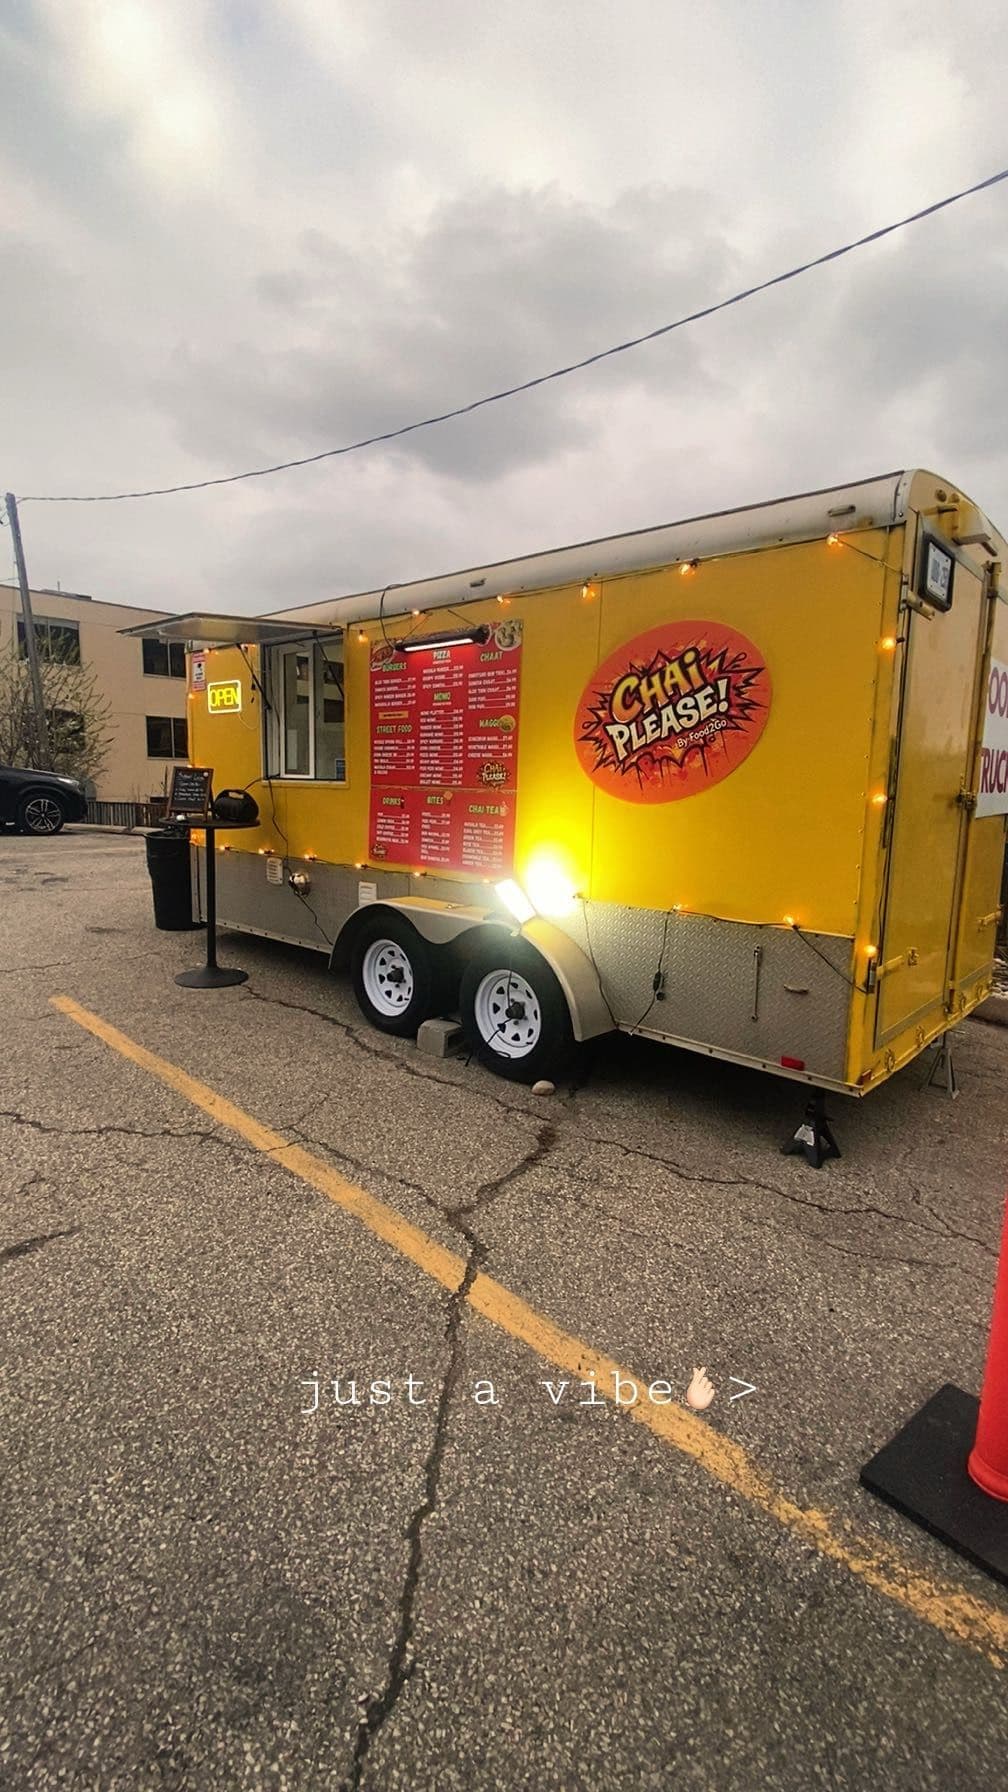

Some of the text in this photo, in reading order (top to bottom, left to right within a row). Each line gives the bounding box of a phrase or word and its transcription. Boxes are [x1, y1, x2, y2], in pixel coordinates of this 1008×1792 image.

[433, 650, 451, 660] PIZZA
[480, 651, 503, 662] CHAAT
[210, 687, 240, 707] OPEN
[988, 666, 1008, 719] OO
[606, 678, 728, 761] PLEASE!
[376, 724, 413, 734] STREET FOOD
[677, 719, 728, 749] By Food2Go
[382, 797, 401, 806] DRINKS
[427, 796, 444, 805] BITES
[468, 804, 499, 814] CHAI TEA
